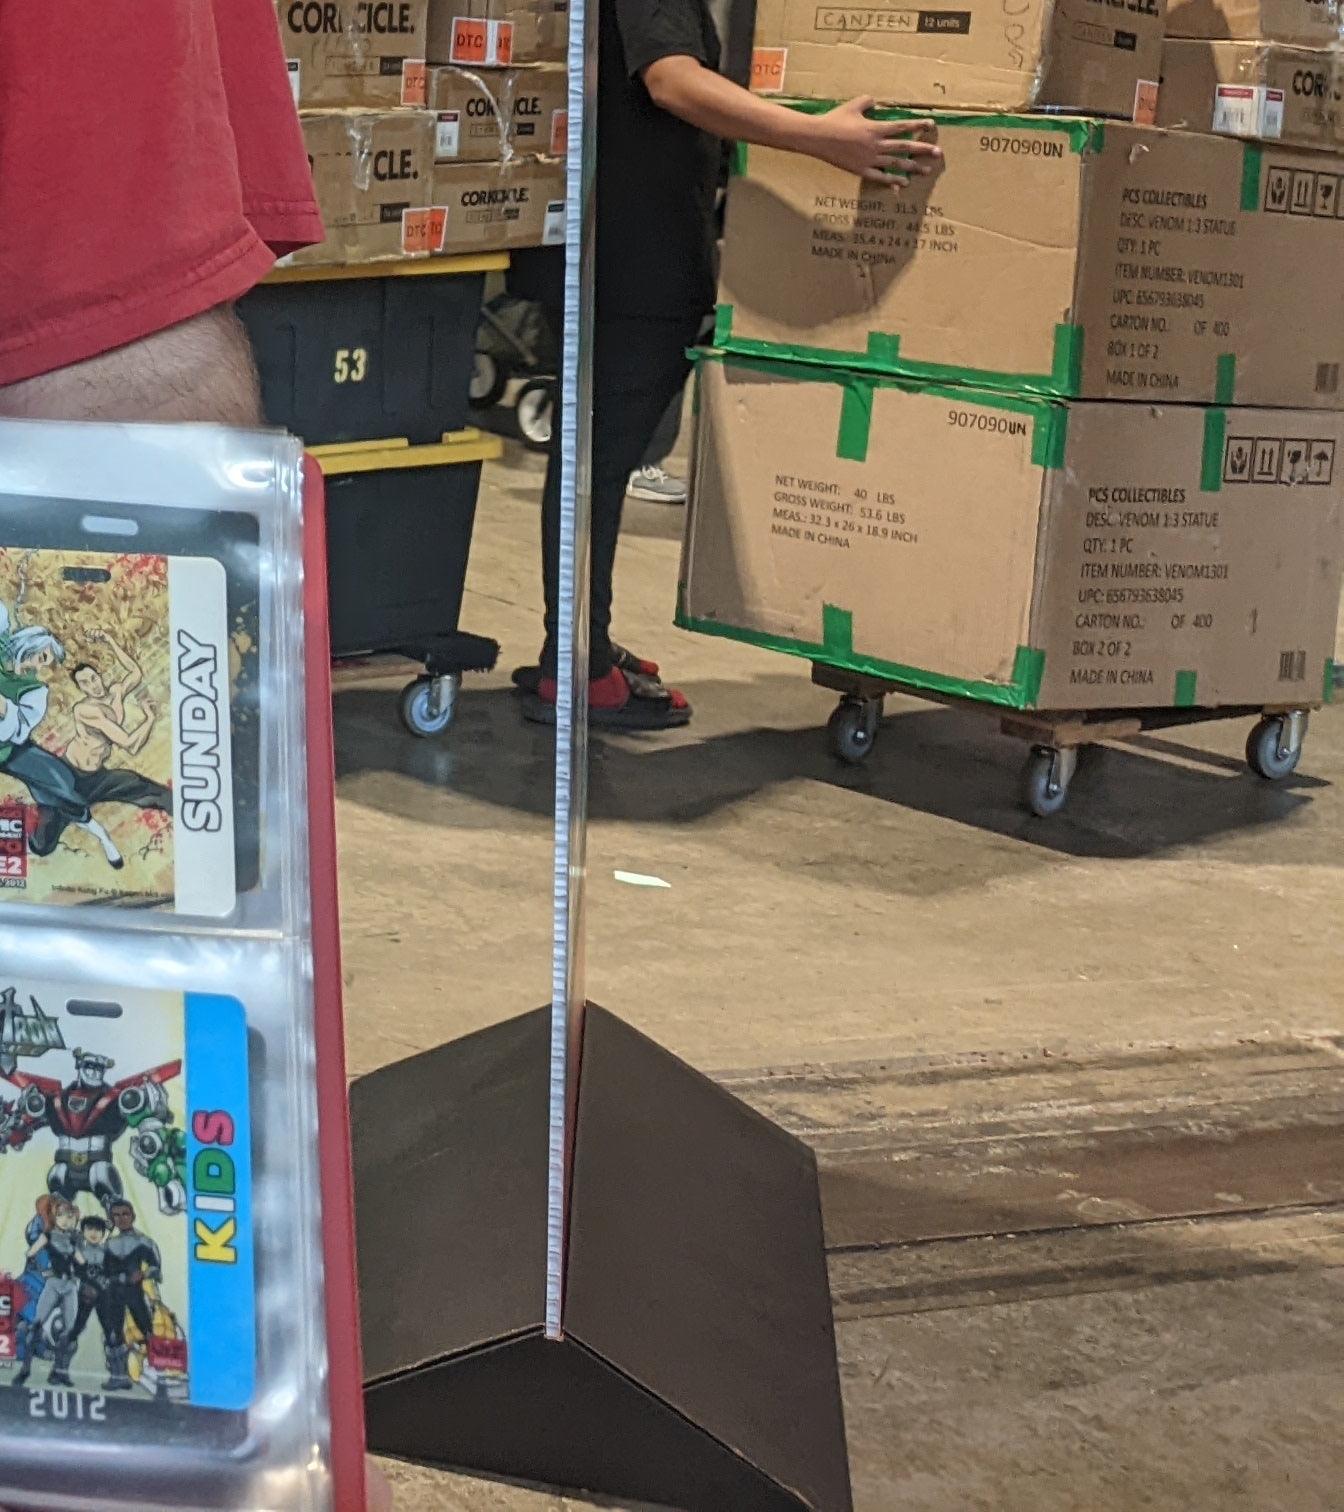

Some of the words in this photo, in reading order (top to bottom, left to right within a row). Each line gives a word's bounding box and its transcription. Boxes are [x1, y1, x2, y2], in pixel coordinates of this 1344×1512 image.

[823, 12, 911, 28] CANTEEN
[936, 17, 960, 29] units
[456, 31, 482, 48] DTC
[980, 136, 1063, 158] 907090UN
[815, 196, 835, 208] NET
[924, 204, 944, 217] LBS
[814, 213, 850, 226] GROSS
[935, 224, 955, 236] LBS
[811, 246, 842, 259] MADE
[848, 250, 859, 261] IN
[861, 252, 896, 264] CHINA
[930, 241, 959, 252] INCH
[334, 348, 367, 384] 53
[947, 410, 1027, 436] 907090UN
[775, 475, 794, 488] NET
[798, 479, 840, 496] WEIGHT:
[854, 488, 868, 500] 40
[877, 492, 895, 504] LBS
[1088, 487, 1109, 503] PCS
[1112, 488, 1186, 503] COLLECTIBLES
[774, 491, 807, 507] GROSS
[810, 498, 853, 515] WEIGHT:
[860, 507, 883, 521] 53.6
[887, 511, 906, 525] LBS
[810, 514, 831, 528] 32.3
[842, 519, 855, 532] 26
[867, 525, 888, 538] 18.9
[890, 530, 919, 543] INCH
[1119, 512, 1160, 528] VENOM
[1163, 513, 1179, 528] 1:3
[1181, 512, 1219, 528] STATUE
[771, 524, 801, 539] MADE
[804, 530, 815, 542] IN
[817, 533, 850, 548] CHINA
[1083, 538, 1107, 554] QTY:
[1119, 538, 1134, 553] PC
[1081, 563, 1108, 578] ITEM
[1112, 564, 1161, 578] NUMBER:
[1165, 564, 1229, 579] VENOM1301
[1079, 589, 1104, 603] UPC:
[1076, 614, 1120, 629] CARTON
[1171, 614, 1186, 629] OF
[1193, 614, 1212, 628] 400
[1073, 641, 1095, 656] BOX
[1107, 641, 1122, 656] OF
[1070, 669, 1103, 685] MADE
[1106, 670, 1117, 685] IN
[1120, 669, 1154, 685] CHINA
[177, 629, 222, 832] SUNDAY
[191, 1109, 238, 1264] KIDS
[28, 1388, 108, 1422] 2012
